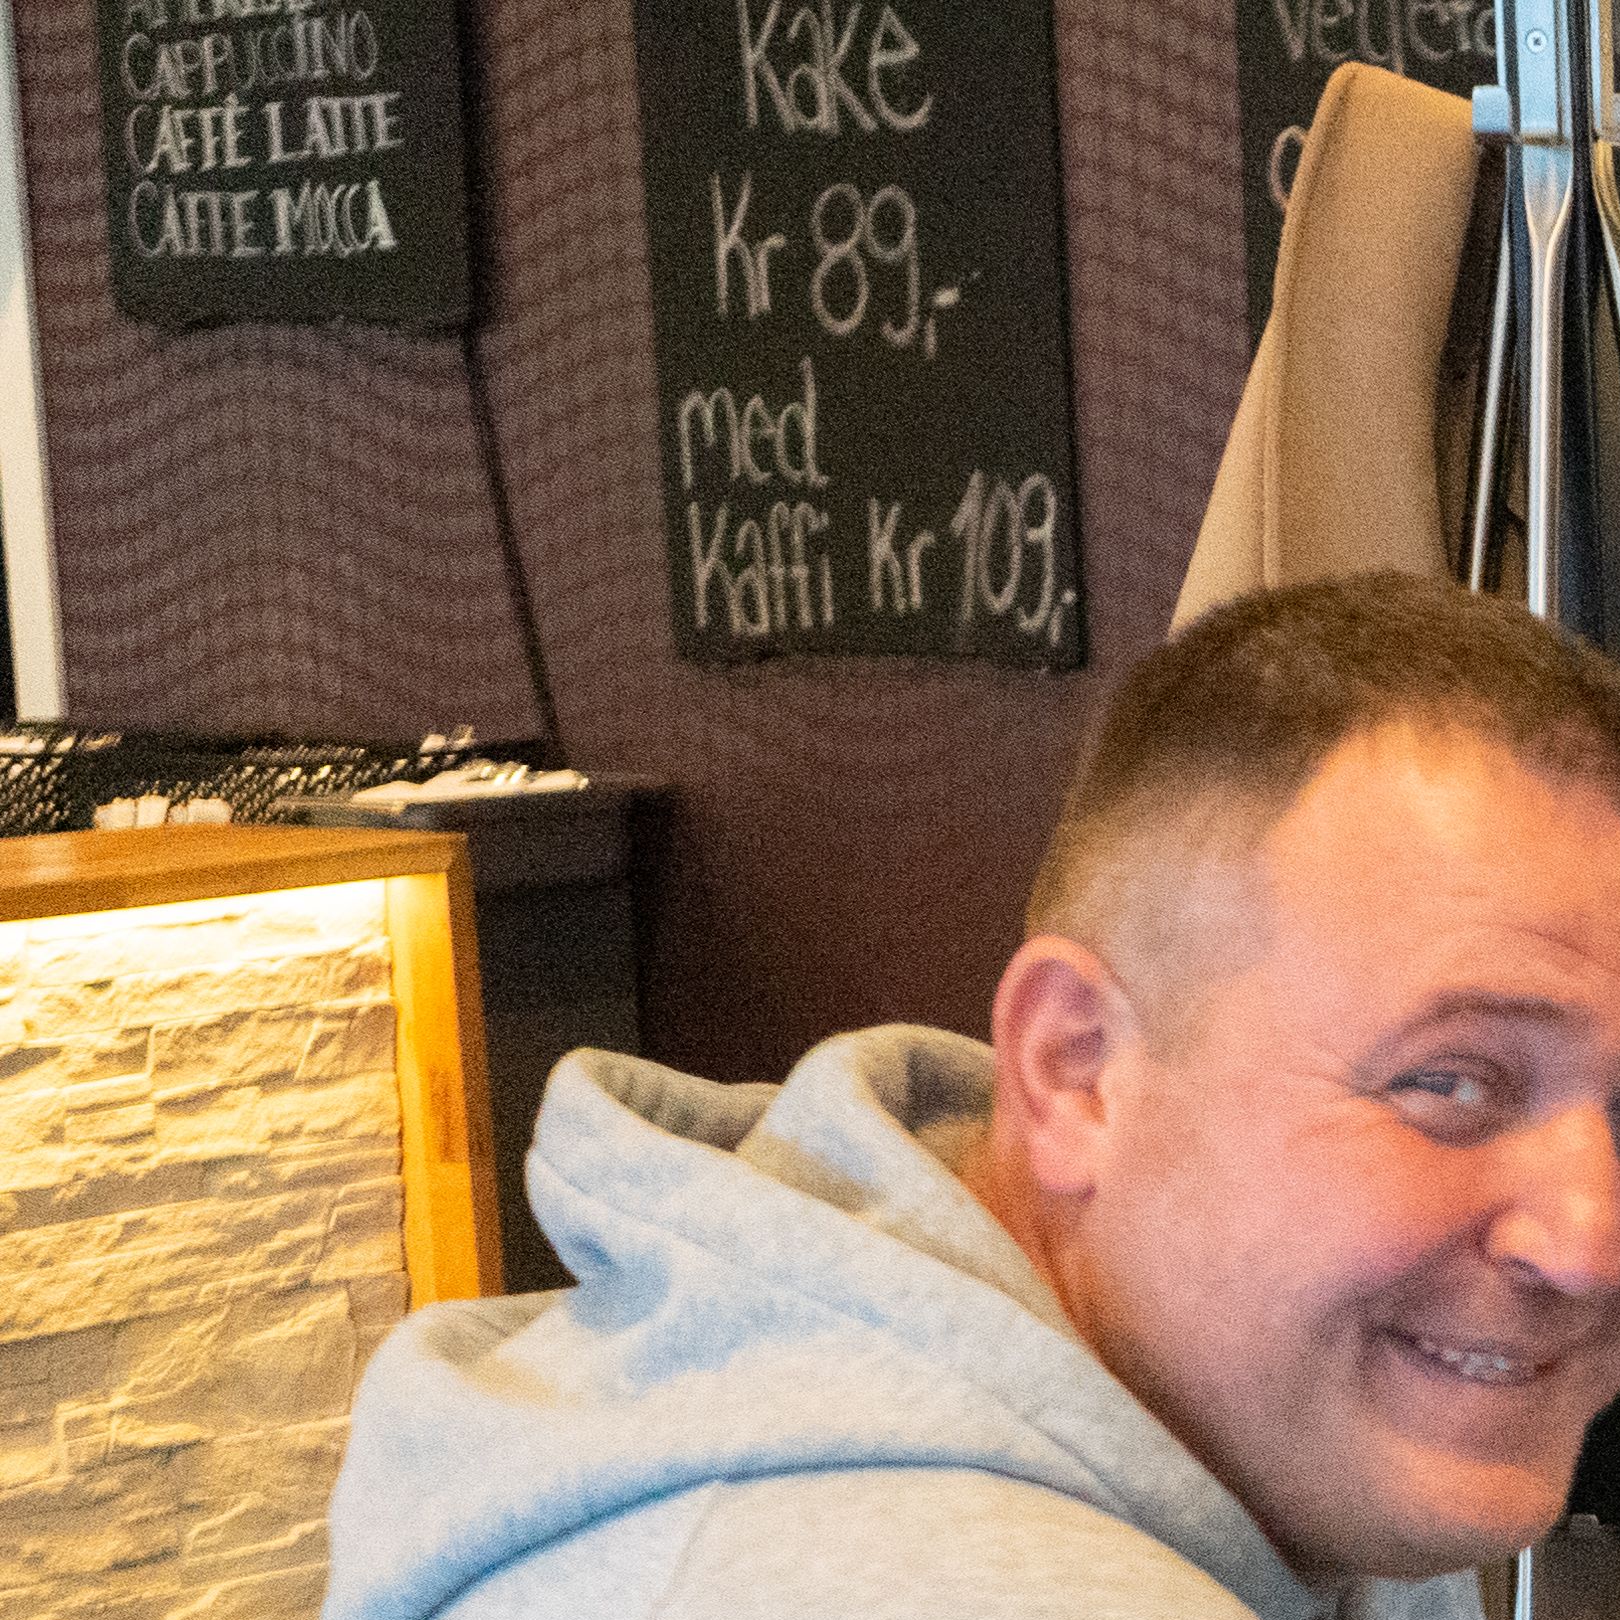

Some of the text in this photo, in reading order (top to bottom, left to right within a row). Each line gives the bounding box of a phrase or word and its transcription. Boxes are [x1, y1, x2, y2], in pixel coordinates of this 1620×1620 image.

[263, 91, 404, 164] LATTE
[737, 0, 933, 134] Kake
[269, 178, 399, 258] MOCCA
[710, 170, 787, 319] Kr
[680, 356, 829, 490] med
[688, 497, 836, 638] Kaffi
[867, 496, 935, 613] Kr
